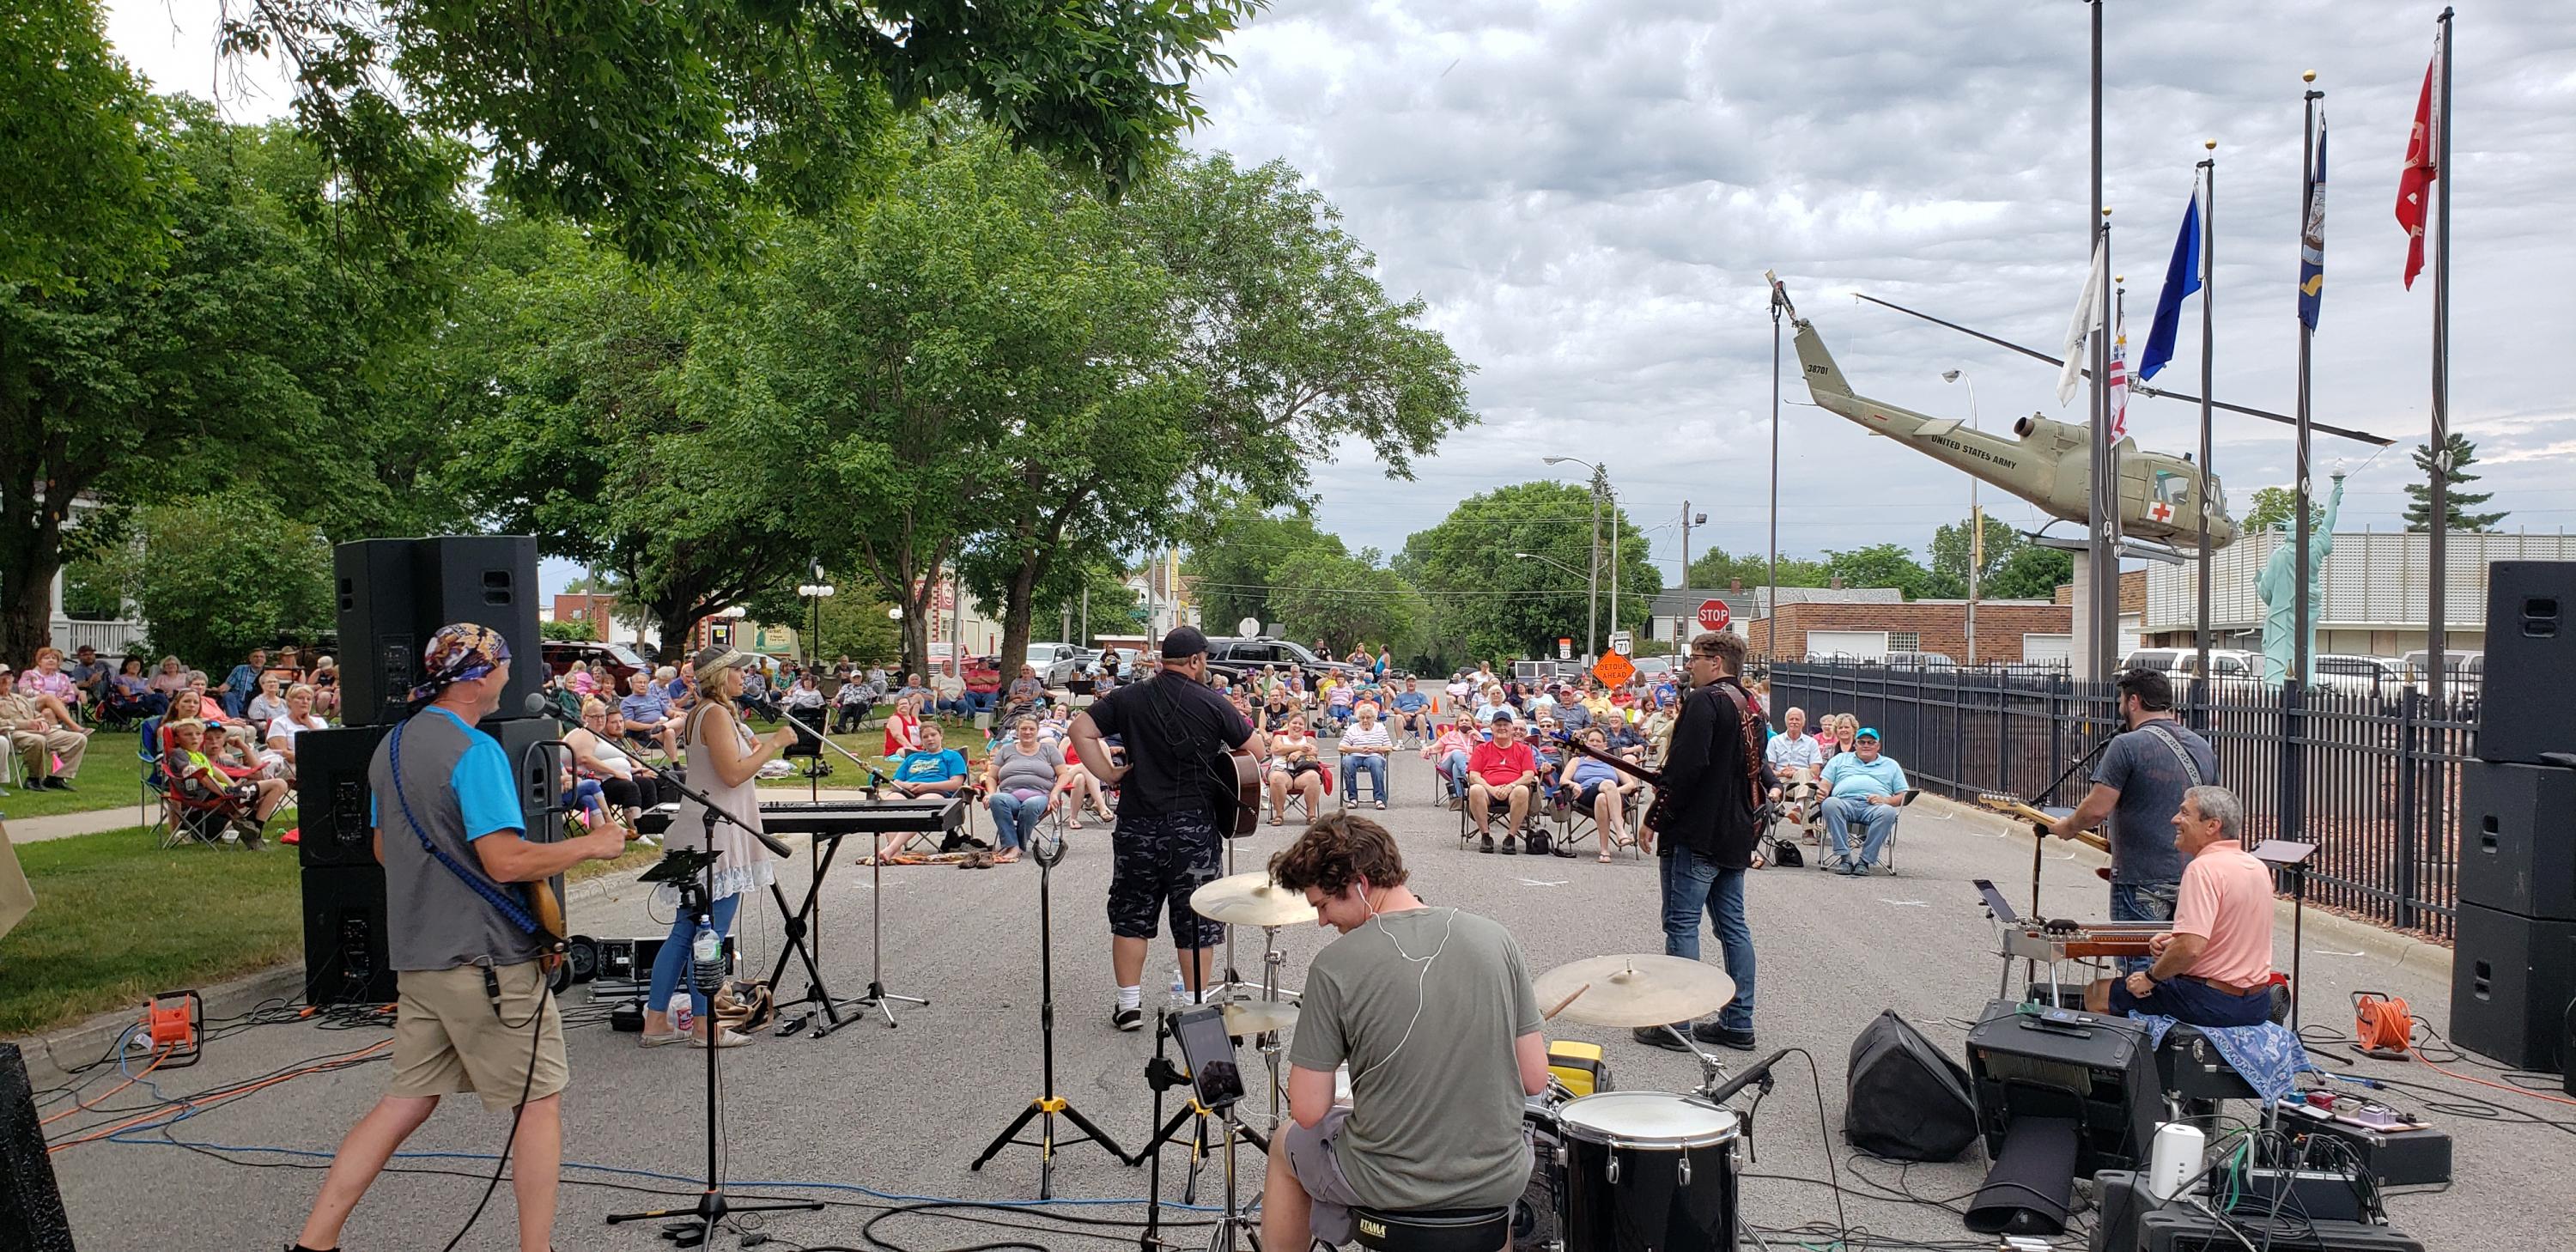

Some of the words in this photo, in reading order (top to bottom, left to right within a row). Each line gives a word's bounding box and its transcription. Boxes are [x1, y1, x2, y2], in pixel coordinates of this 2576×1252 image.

[1807, 364, 1829, 376] 38701
[1931, 434, 1960, 451] UNITED
[1962, 445, 1991, 461] STATES
[1992, 455, 2017, 470] ARMY
[1699, 609, 1728, 622] STOP
[1617, 643, 1627, 652] 71
[1600, 662, 1627, 671] DETOUR
[1359, 1218, 1387, 1236] TAMA
